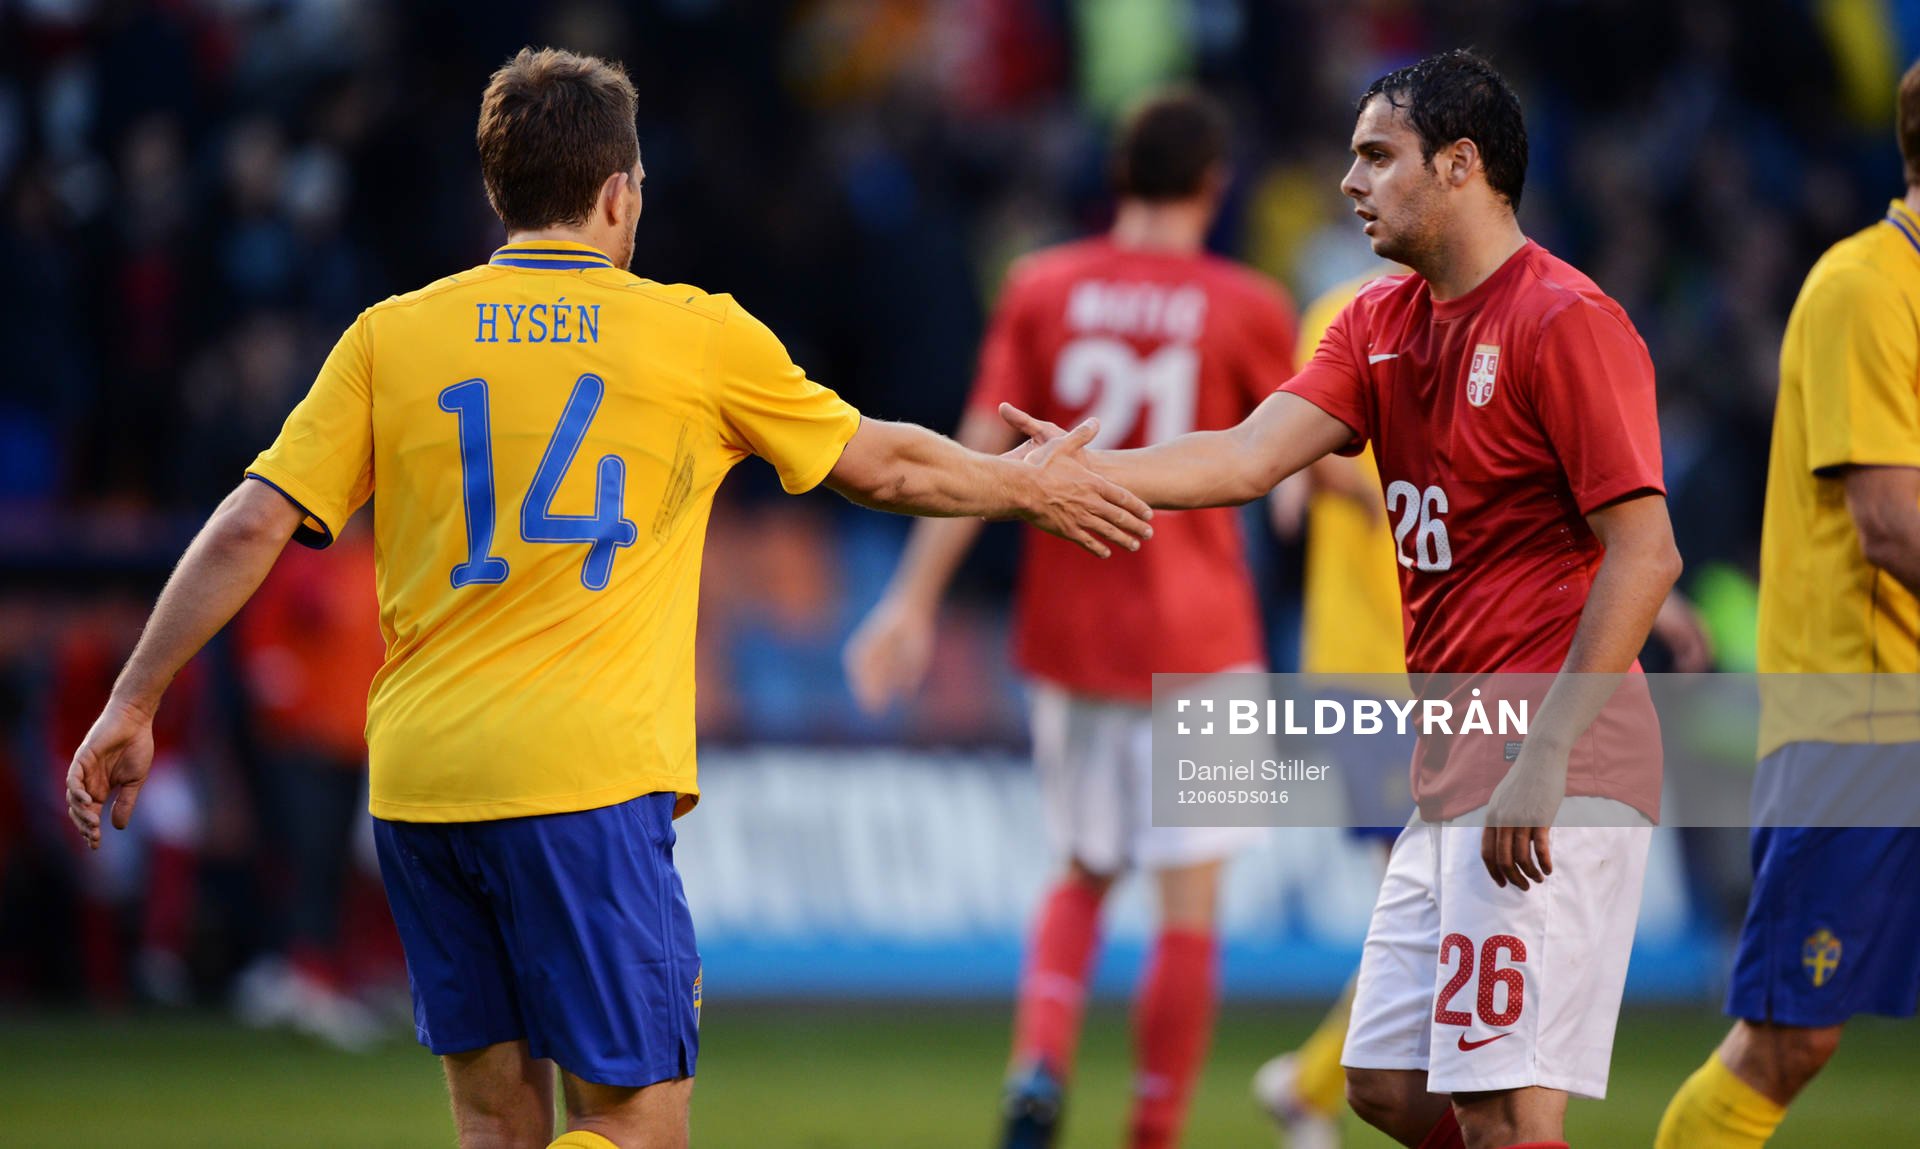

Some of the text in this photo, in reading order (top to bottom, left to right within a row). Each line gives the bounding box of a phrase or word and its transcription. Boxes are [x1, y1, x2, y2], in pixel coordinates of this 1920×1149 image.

[475, 297, 600, 343] HYSÉN
[1054, 337, 1199, 451] 21
[438, 373, 637, 591] 14
[1386, 480, 1452, 571] 26
[1434, 932, 1527, 1027] 26
